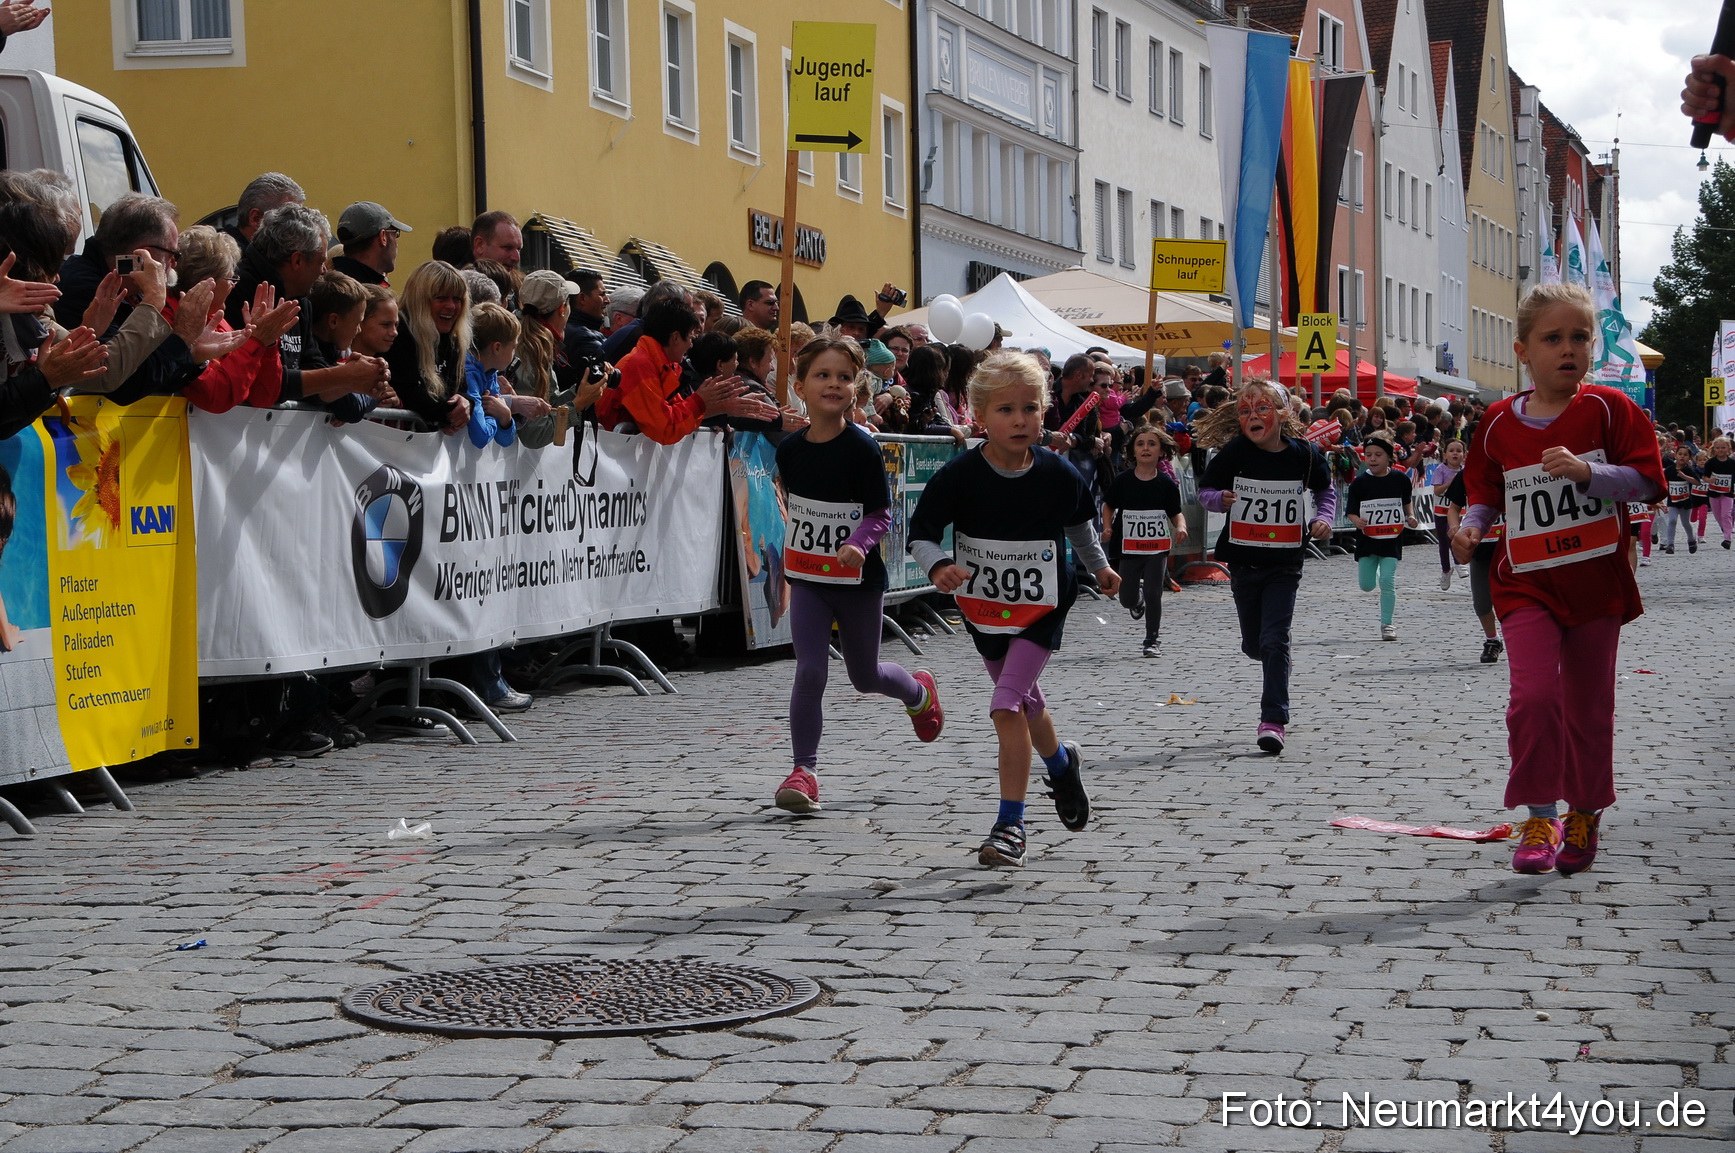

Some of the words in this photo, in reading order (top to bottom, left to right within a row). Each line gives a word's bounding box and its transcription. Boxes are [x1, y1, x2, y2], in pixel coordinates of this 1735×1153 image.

[794, 56, 872, 81] Jugend-
[815, 82, 851, 102] lauf
[1157, 253, 1220, 268] Schnupper-
[1177, 269, 1198, 280] lauf
[1302, 315, 1333, 327] Block
[1304, 331, 1328, 360] A
[1709, 386, 1720, 400] B
[355, 466, 423, 517] BMW
[1235, 484, 1259, 494] PARTL
[1260, 487, 1295, 495] Neumarkt
[440, 482, 495, 543] BMW
[496, 478, 648, 544] EfficientDynamics
[789, 501, 805, 515] PARTL
[805, 507, 847, 520] Neumarkt
[1240, 496, 1298, 524] 7316
[1365, 508, 1401, 525] 7279
[790, 517, 851, 554] 7348
[1127, 521, 1166, 538] 7053
[958, 542, 984, 559] PARTL
[985, 550, 1038, 561] Neumarkt
[1545, 534, 1583, 555] Lisa
[60, 576, 99, 593] Pflaster
[434, 560, 494, 607] Weniger
[562, 548, 584, 584] Mehr
[587, 542, 651, 580] Fahrfreude.
[966, 560, 1045, 602] 7393
[62, 601, 136, 624] Außenplatten
[64, 632, 114, 652] Palisaden
[66, 662, 102, 682] Stufen
[68, 687, 151, 711] Gartenmauern
